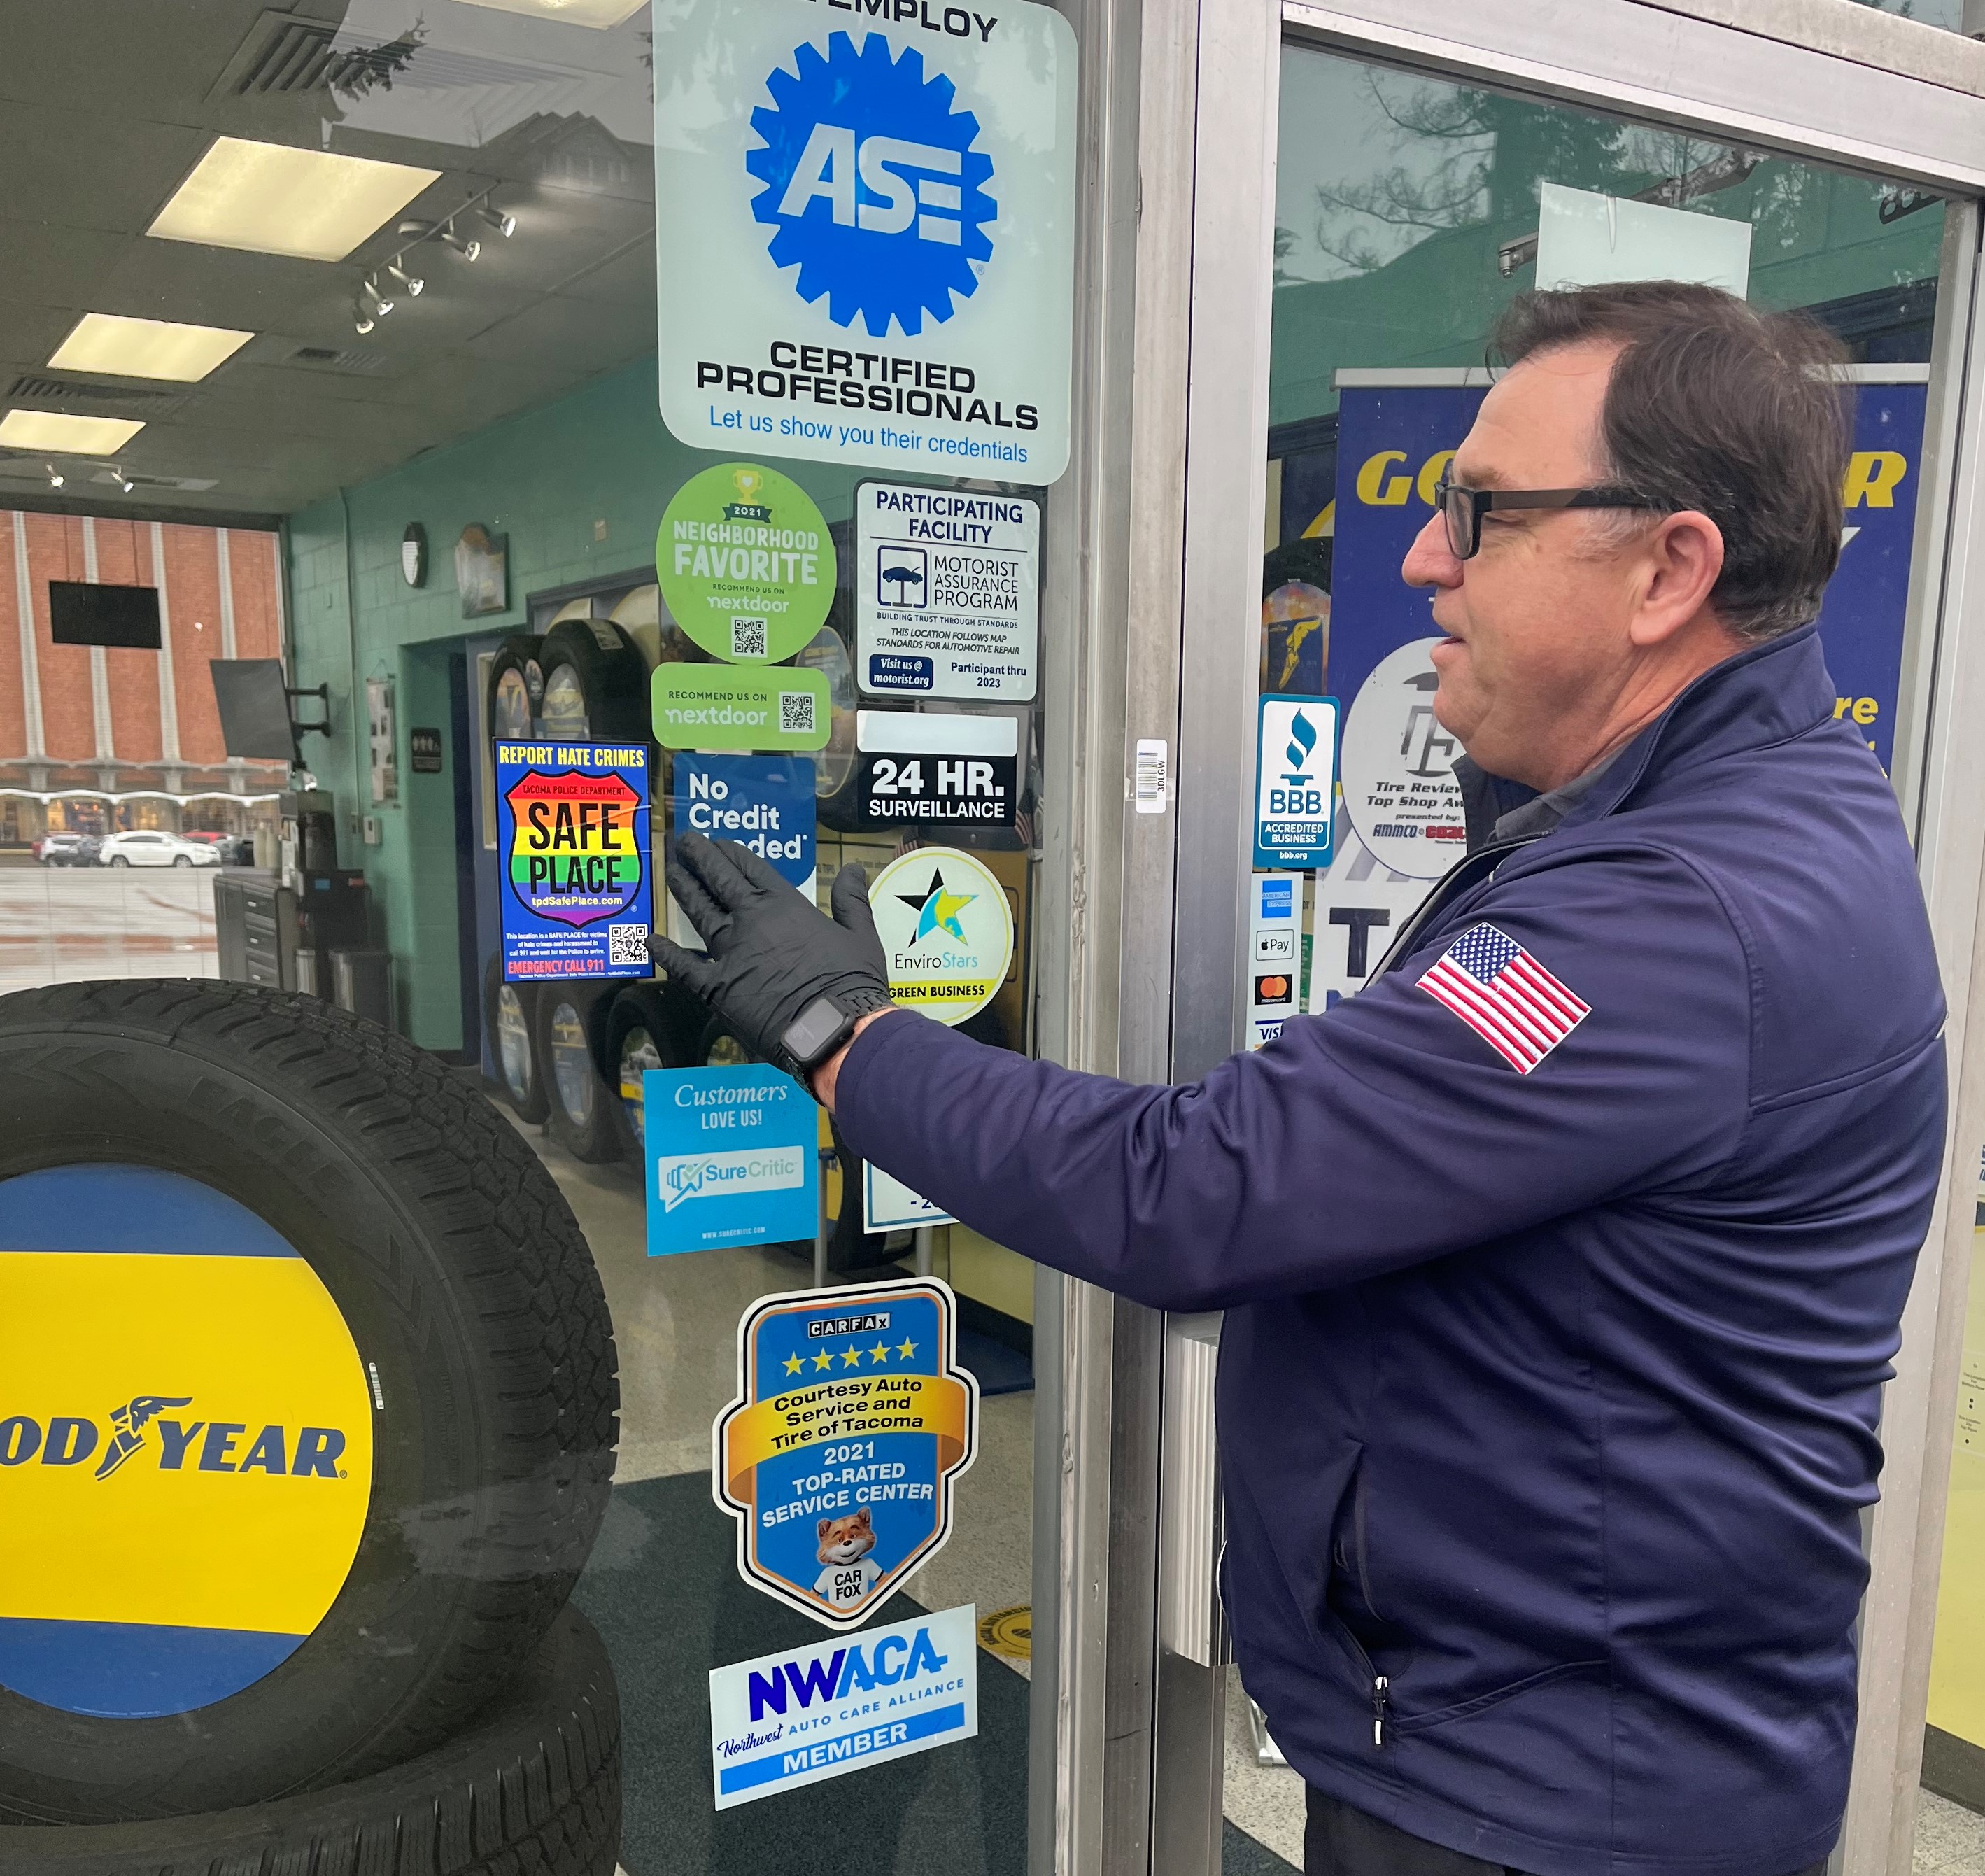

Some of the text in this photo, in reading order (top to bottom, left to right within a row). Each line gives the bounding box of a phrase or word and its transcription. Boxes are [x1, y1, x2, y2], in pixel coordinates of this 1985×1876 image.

[777, 122, 962, 246] ASE
[770, 341, 975, 394] CERTIFIED
[697, 360, 1039, 430] PROFESSIONALS
[710, 405, 1029, 463] Let us show you their credentials
[733, 505, 761, 516] 2021
[876, 490, 1023, 523] PARTICIPATING
[674, 520, 819, 551] NEIGHBORHOOD
[909, 518, 993, 544] FACILITY
[674, 544, 817, 584] FAVORITE
[934, 555, 1019, 577] MOTORIST
[712, 584, 761, 594] RECOMMEND
[934, 574, 1019, 593] ASSURANCE
[707, 595, 789, 613] nextdoor
[934, 589, 1018, 612] PROGRAM
[877, 612, 1018, 629] BUILDING TRUST THROUGH STANDARDS
[876, 637, 1020, 655] STANDARDS FOR AUTOMOTIVE REPAIR
[891, 627, 1007, 643] THIS LOCATION FOLLOWS MAP
[880, 658, 923, 672] Visit us @
[951, 662, 1026, 676] Participant thru
[873, 673, 930, 688] motorist.org
[977, 677, 1001, 688] 2023
[668, 691, 768, 702] RECOMMEND US ON
[665, 705, 767, 726] nextdoor
[500, 745, 645, 768] REPORT HATE CRIMES
[688, 773, 728, 800] No
[871, 759, 1005, 797] 24 HR.
[1376, 782, 1405, 792] Tire
[523, 784, 626, 796] TACOMA POLICE DEPARTMENT
[868, 799, 1005, 819] SURVEILLANCE
[1269, 789, 1322, 814] BBB
[1367, 795, 1394, 808] Top
[1399, 796, 1438, 809] Shop
[528, 801, 621, 850] SAFE
[688, 803, 780, 831] Credit
[1265, 823, 1324, 833] ACCREDITED
[1271, 833, 1317, 844] BUSINESS
[1372, 824, 1418, 838] AMMCO
[1279, 851, 1308, 861] bbb.org
[530, 856, 623, 895] PLACE
[532, 896, 623, 908] tpdSafePlace.com
[1270, 938, 1290, 952] Pay
[508, 959, 605, 975] EMERGENCY CALL 911
[895, 952, 978, 970] EnviroStars
[889, 985, 985, 999] GREEN BUSINESS
[1259, 1027, 1283, 1040] VIS
[674, 1083, 788, 1108] Customers
[701, 1108, 762, 1130] LOVE US!
[705, 1158, 795, 1182] SureCritic
[808, 1313, 890, 1337] CARFAX
[774, 1378, 922, 1413] Courtesy Auto
[786, 1396, 911, 1427] Service and
[770, 1415, 924, 1451] Tire of Tacoma
[824, 1441, 875, 1466] 2021
[792, 1462, 905, 1496] TOP-RATED
[762, 1483, 934, 1529] SERVICE CENTER
[834, 1568, 862, 1586] CAR
[836, 1582, 861, 1600] FOX
[748, 1627, 948, 1723] NWACA
[717, 1678, 965, 1758] Northwest AUTO CARE ALLIANCE
[783, 1722, 908, 1775] MEMBER
